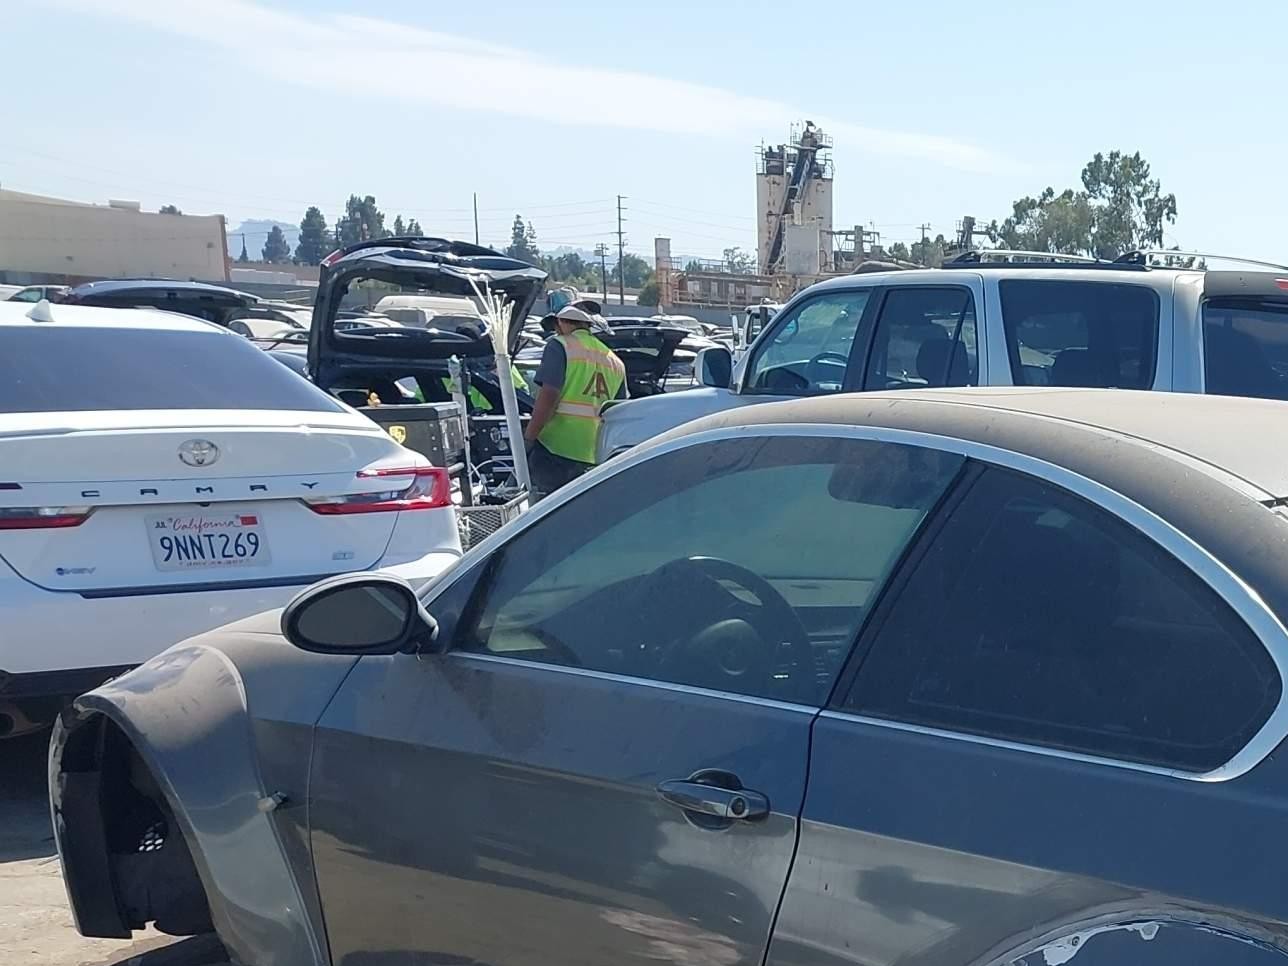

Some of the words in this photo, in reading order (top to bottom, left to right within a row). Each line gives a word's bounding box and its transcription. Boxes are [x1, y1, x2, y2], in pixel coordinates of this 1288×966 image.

[81, 482, 319, 498] CAMRY
[172, 516, 242, 533] California
[159, 532, 259, 562] 9NNT269
